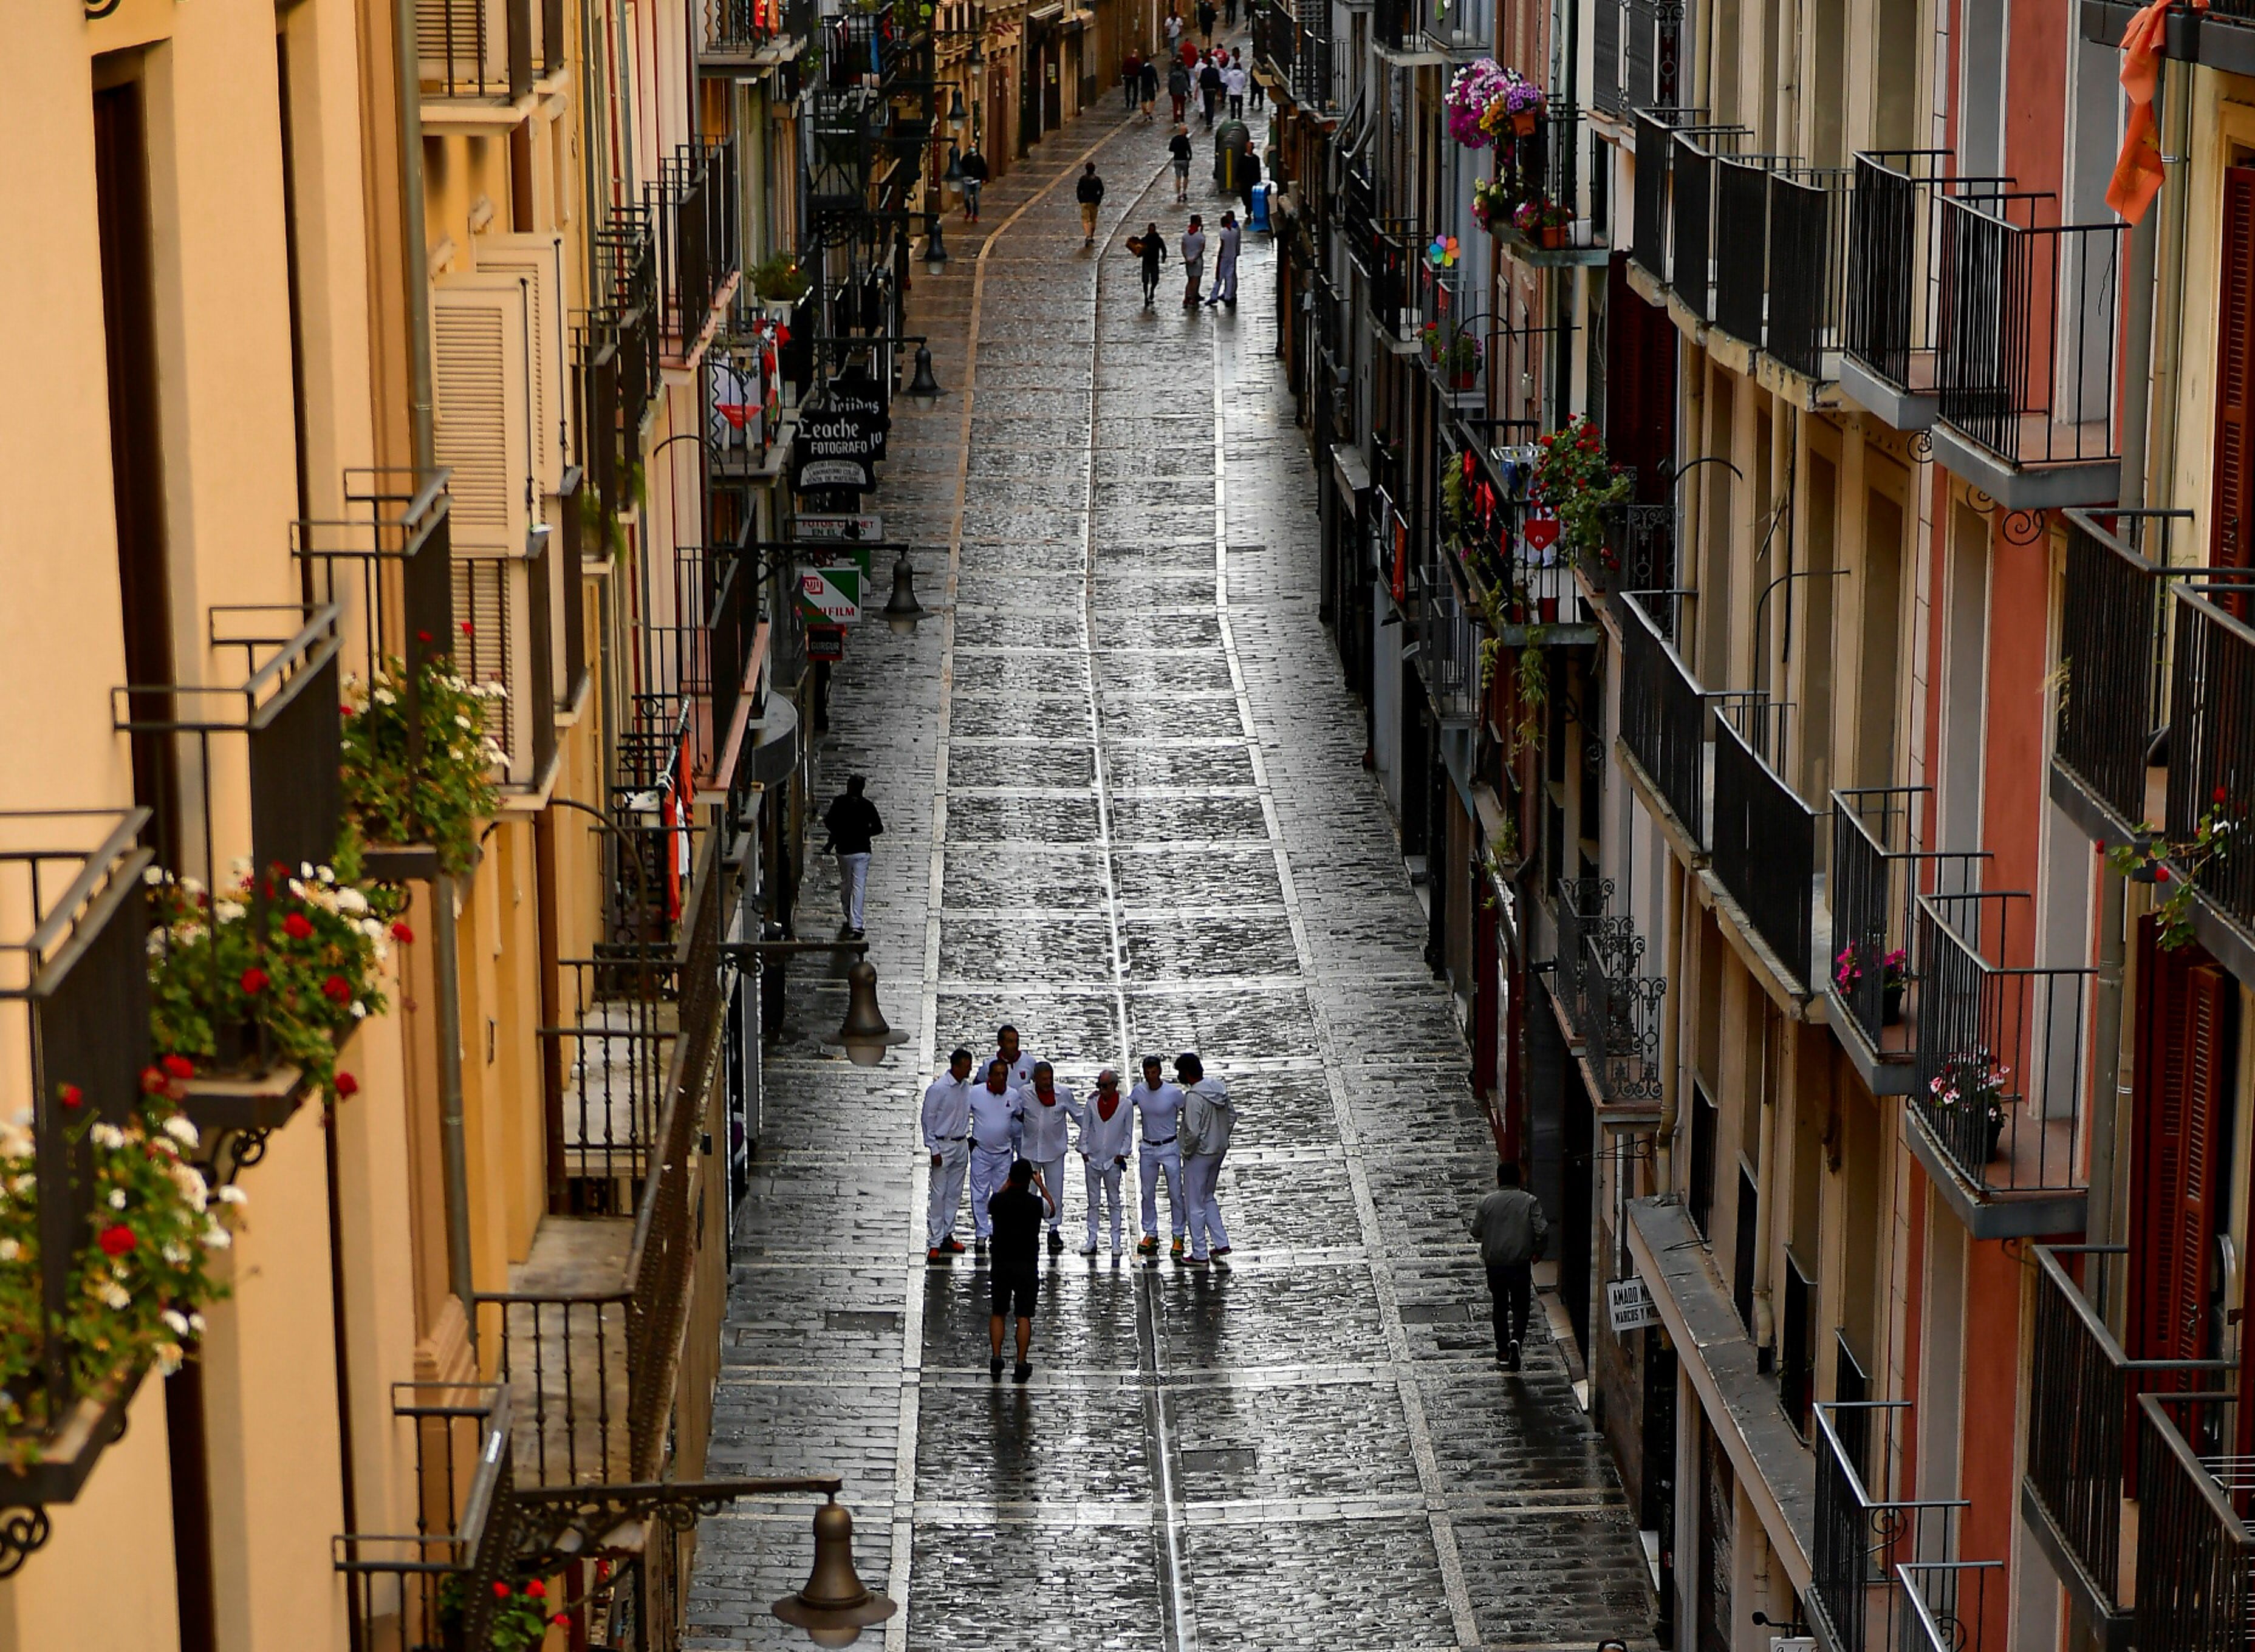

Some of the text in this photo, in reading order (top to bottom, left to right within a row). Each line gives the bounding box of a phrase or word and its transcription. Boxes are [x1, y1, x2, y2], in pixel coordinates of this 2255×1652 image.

[798, 417, 860, 439] Leache
[811, 440, 867, 454] FOTOGRAFO
[1613, 1286, 1638, 1306] AMADO
[1615, 1309, 1638, 1325] MARCOS
[1640, 1308, 1644, 1320] Y
